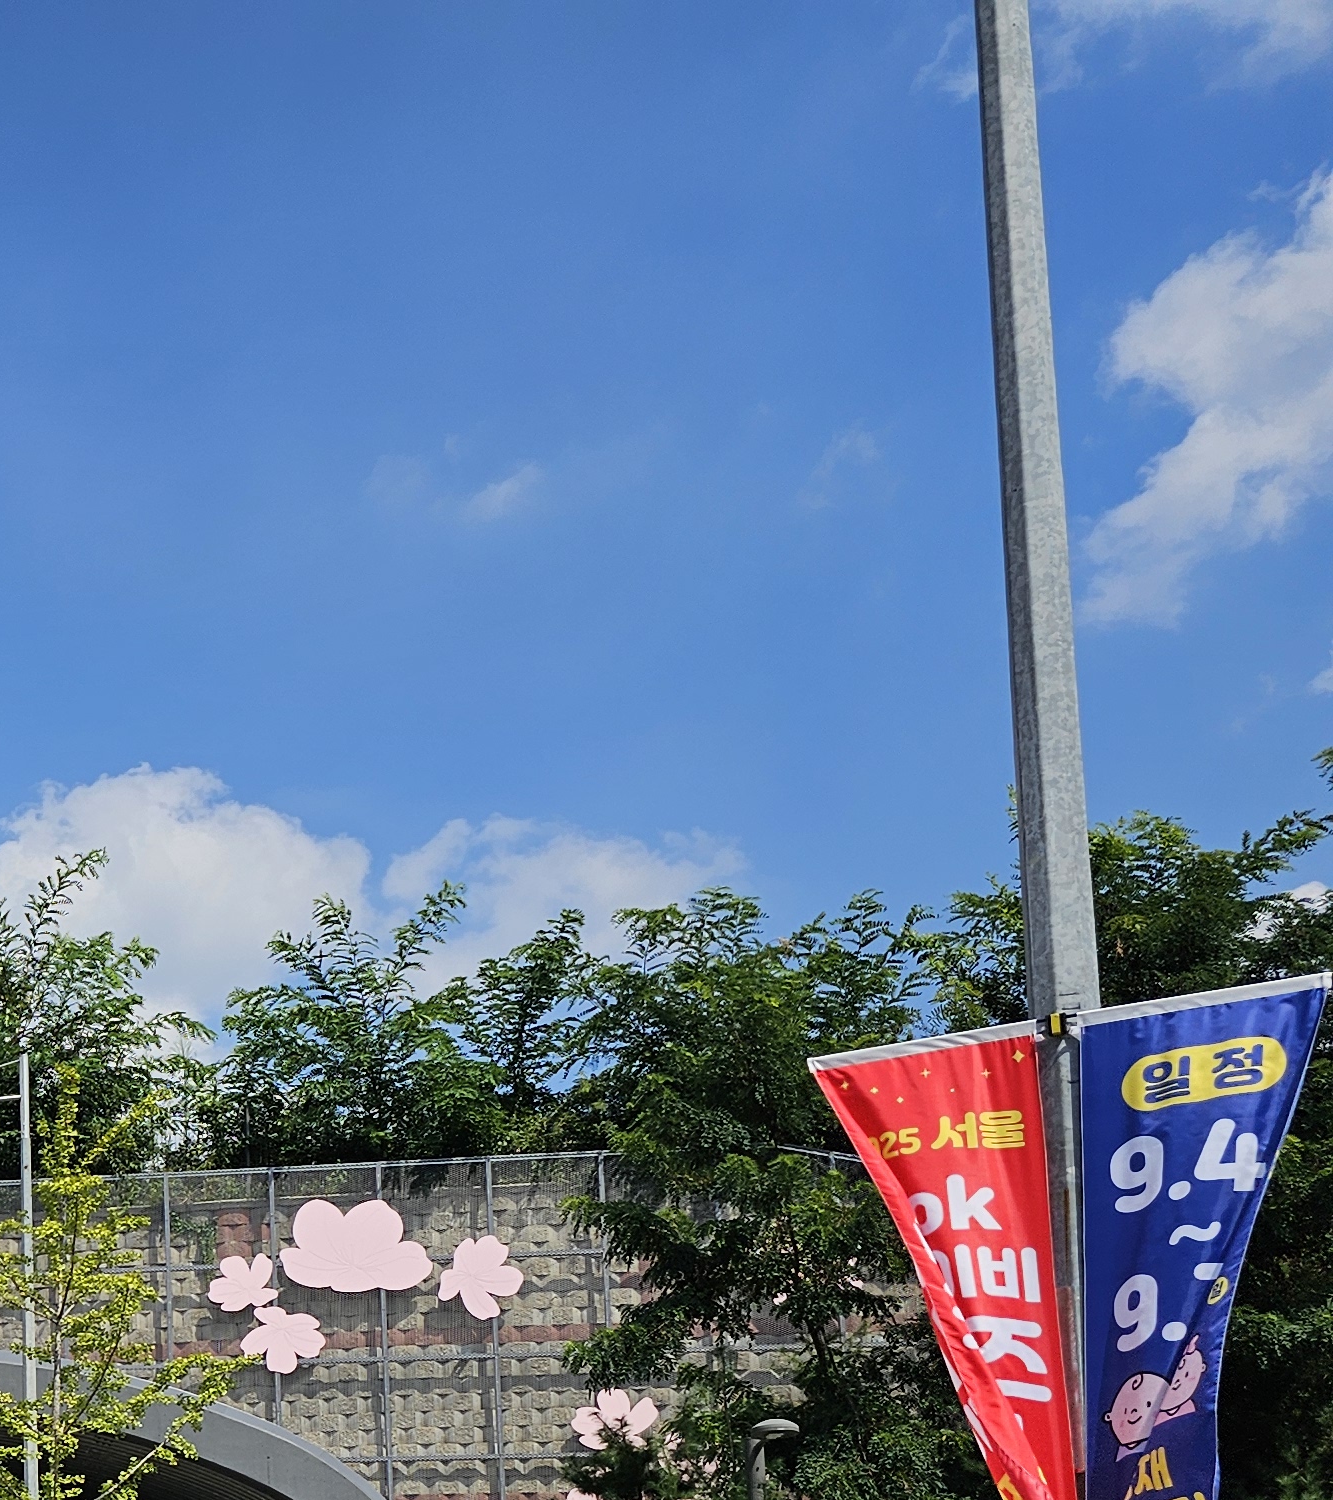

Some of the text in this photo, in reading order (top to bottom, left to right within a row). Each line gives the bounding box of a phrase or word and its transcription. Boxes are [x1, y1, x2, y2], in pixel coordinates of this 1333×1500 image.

[931, 1110, 1025, 1149] 서울
[1110, 1118, 1266, 1213] 9.4
[908, 1174, 1002, 1236] ok
